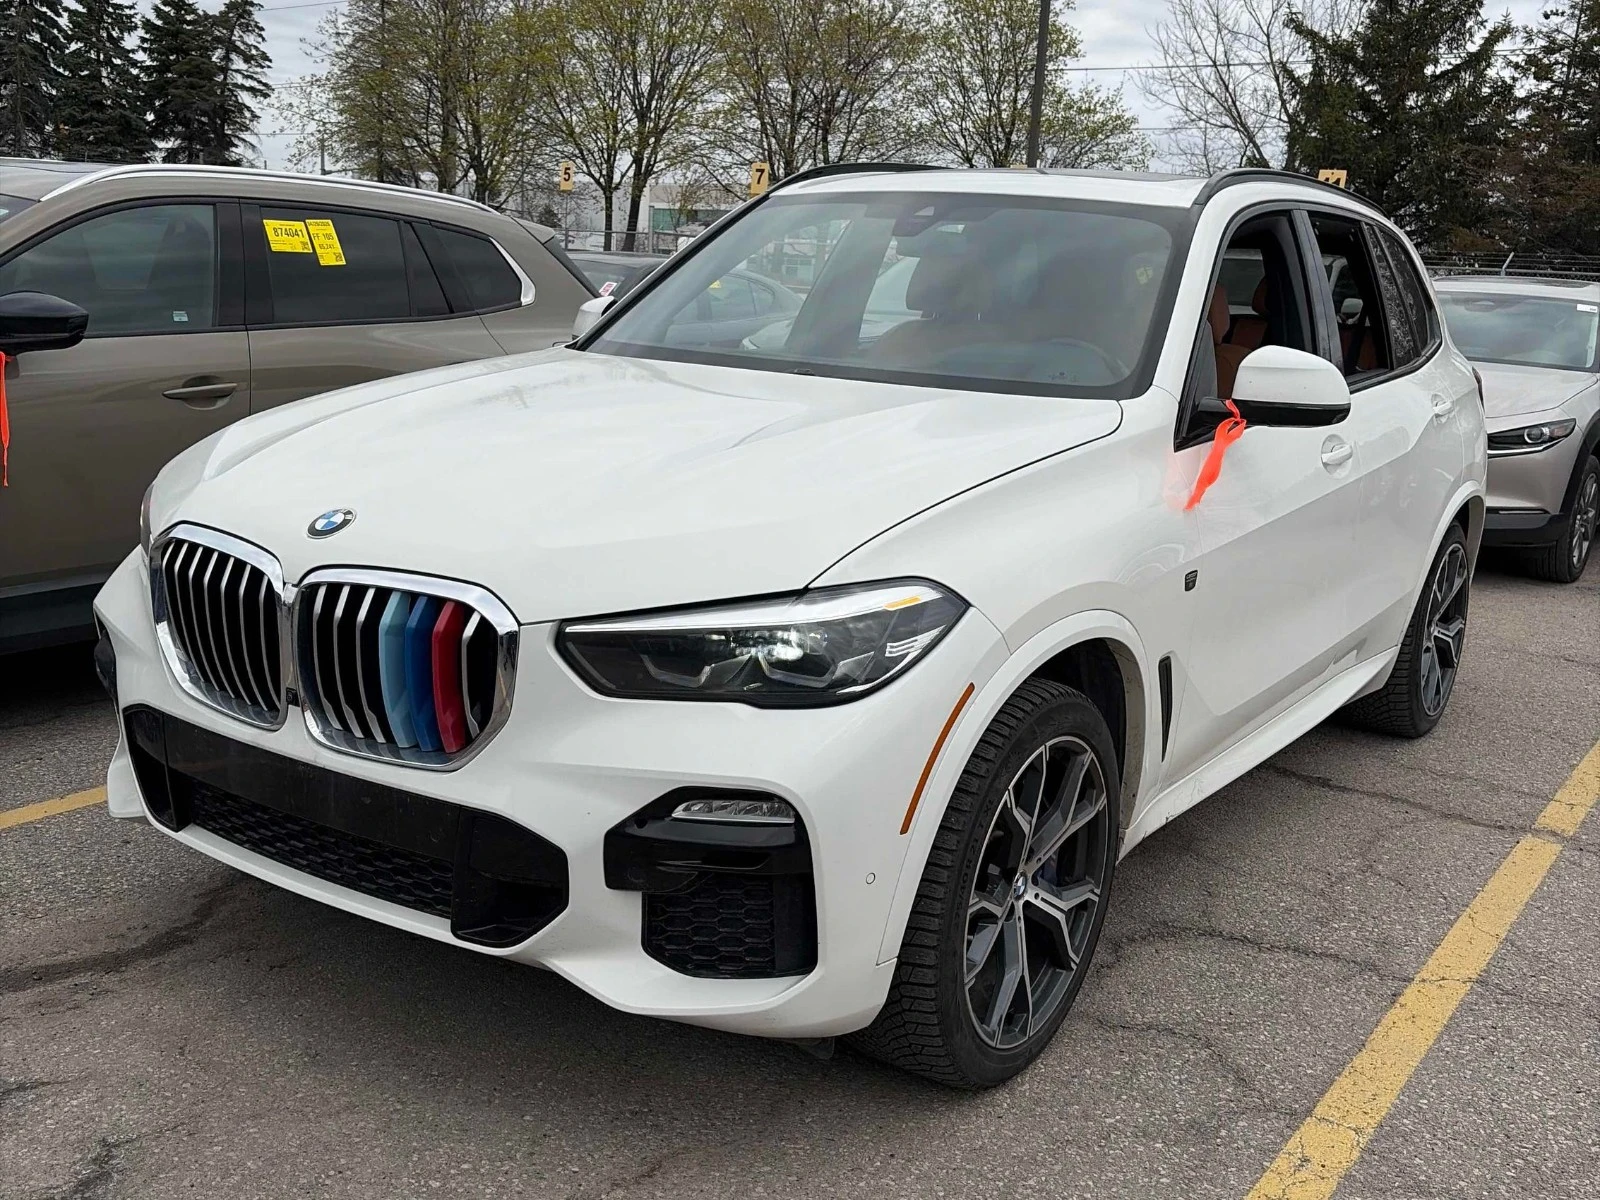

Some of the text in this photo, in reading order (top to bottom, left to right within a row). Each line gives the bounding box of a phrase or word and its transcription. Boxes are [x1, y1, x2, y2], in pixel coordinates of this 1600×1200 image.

[563, 166, 571, 181] 5
[755, 168, 765, 184] 7
[273, 227, 305, 238] 874041
[312, 232, 320, 240] FF
